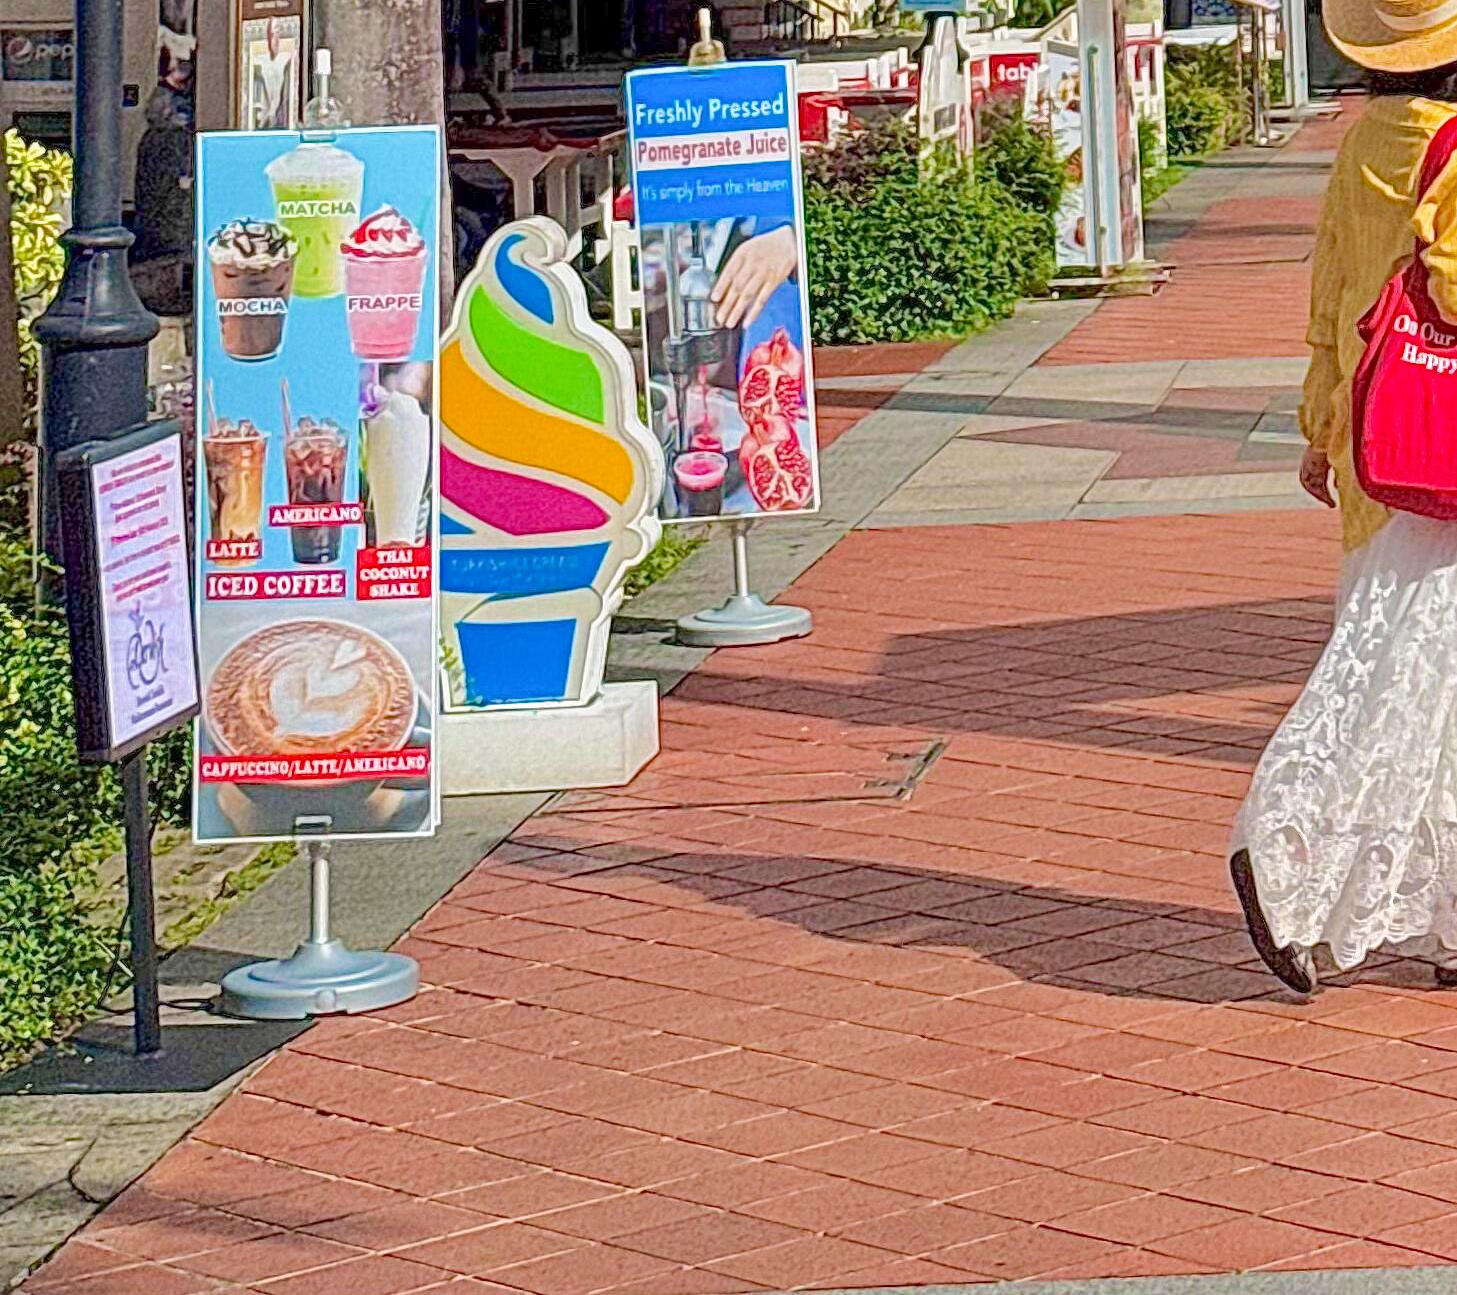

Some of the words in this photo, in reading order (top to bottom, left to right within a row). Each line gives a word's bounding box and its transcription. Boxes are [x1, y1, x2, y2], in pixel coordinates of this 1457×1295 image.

[636, 99, 702, 128] Freshly
[709, 93, 784, 121] Pressed
[638, 138, 741, 165] Pomegranate
[746, 131, 787, 155] Juice
[697, 179, 723, 197] from
[725, 179, 744, 194] the
[747, 177, 789, 193] Heaven
[280, 202, 356, 216] MATCHA
[219, 299, 286, 313] MOCHA
[348, 297, 421, 311] FRAPPE
[1421, 322, 1455, 346] Our
[272, 507, 361, 524] AMERICANO
[208, 542, 259, 559] LATTE
[376, 550, 413, 564] THAI
[360, 567, 430, 581] COCONUT
[208, 575, 258, 598] ICED
[263, 573, 343, 596] COFFEE
[370, 583, 420, 597] SHAKE
[202, 755, 427, 778] CAPPUCCINO/LATTE/AMERICANO
